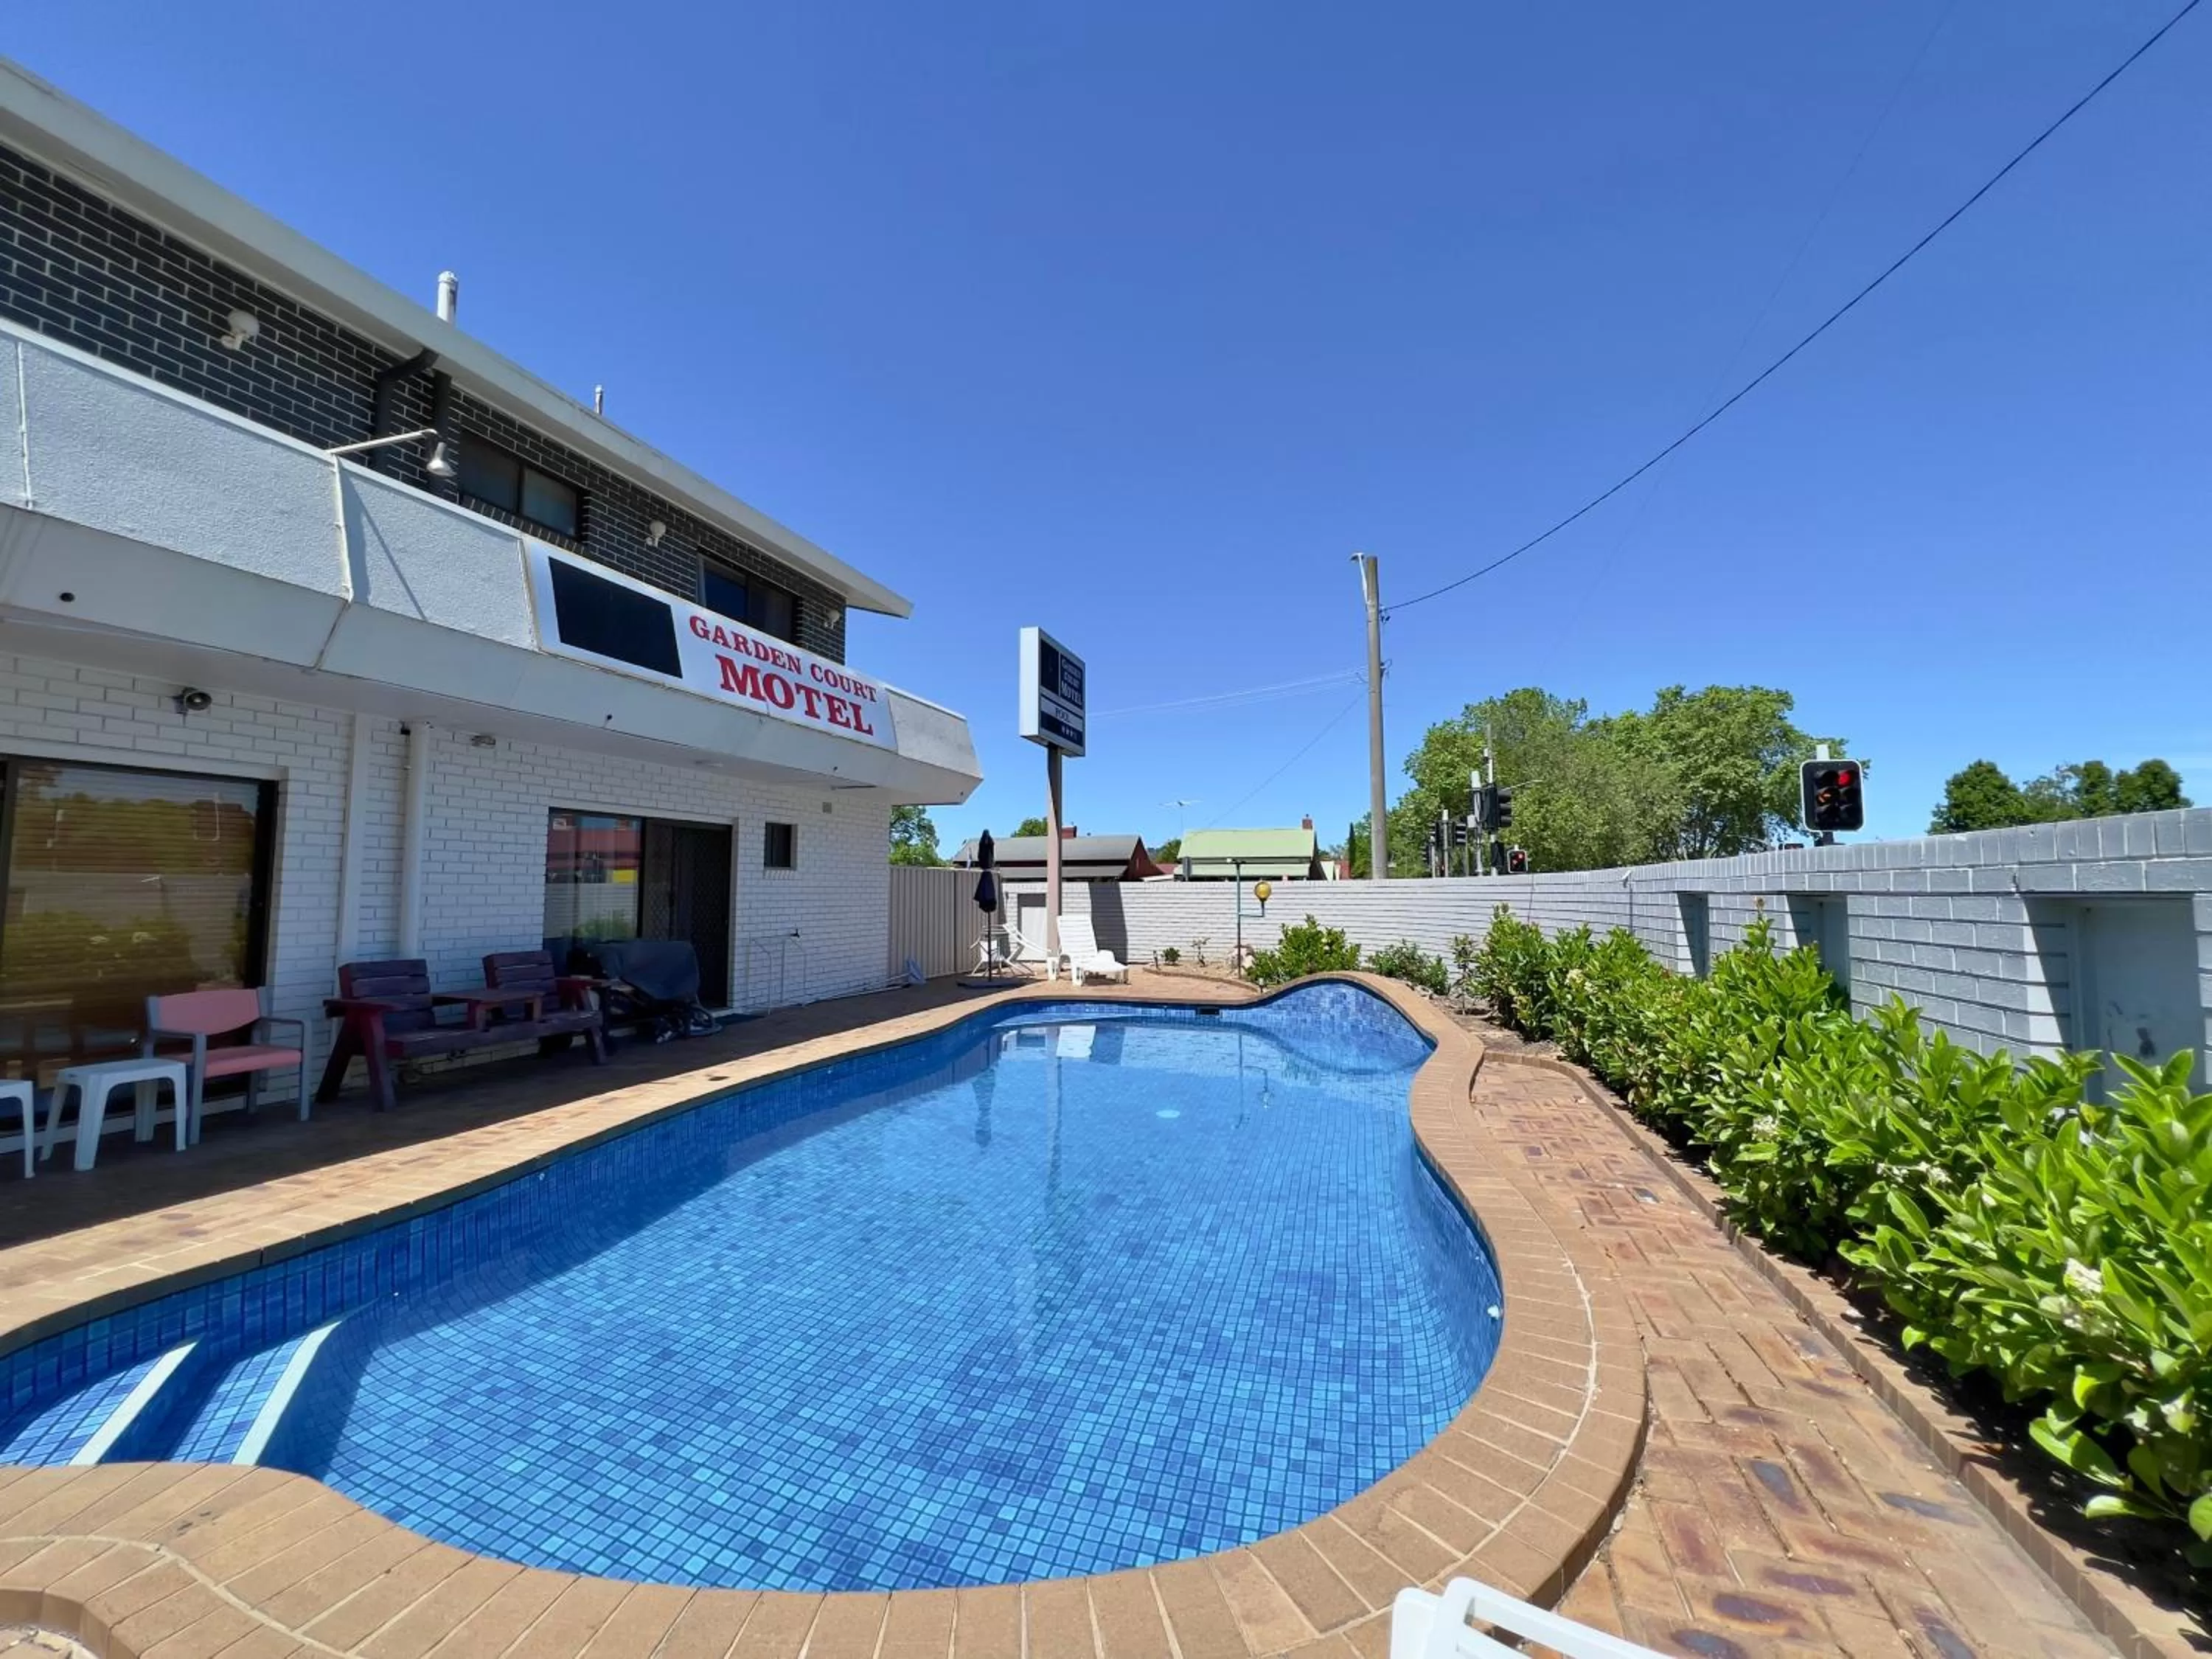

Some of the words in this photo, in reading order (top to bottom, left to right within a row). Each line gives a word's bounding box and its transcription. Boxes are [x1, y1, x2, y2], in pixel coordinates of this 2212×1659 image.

[689, 616, 801, 674] GARDEN
[810, 664, 877, 703] COURT
[715, 654, 874, 736] MOTEL
